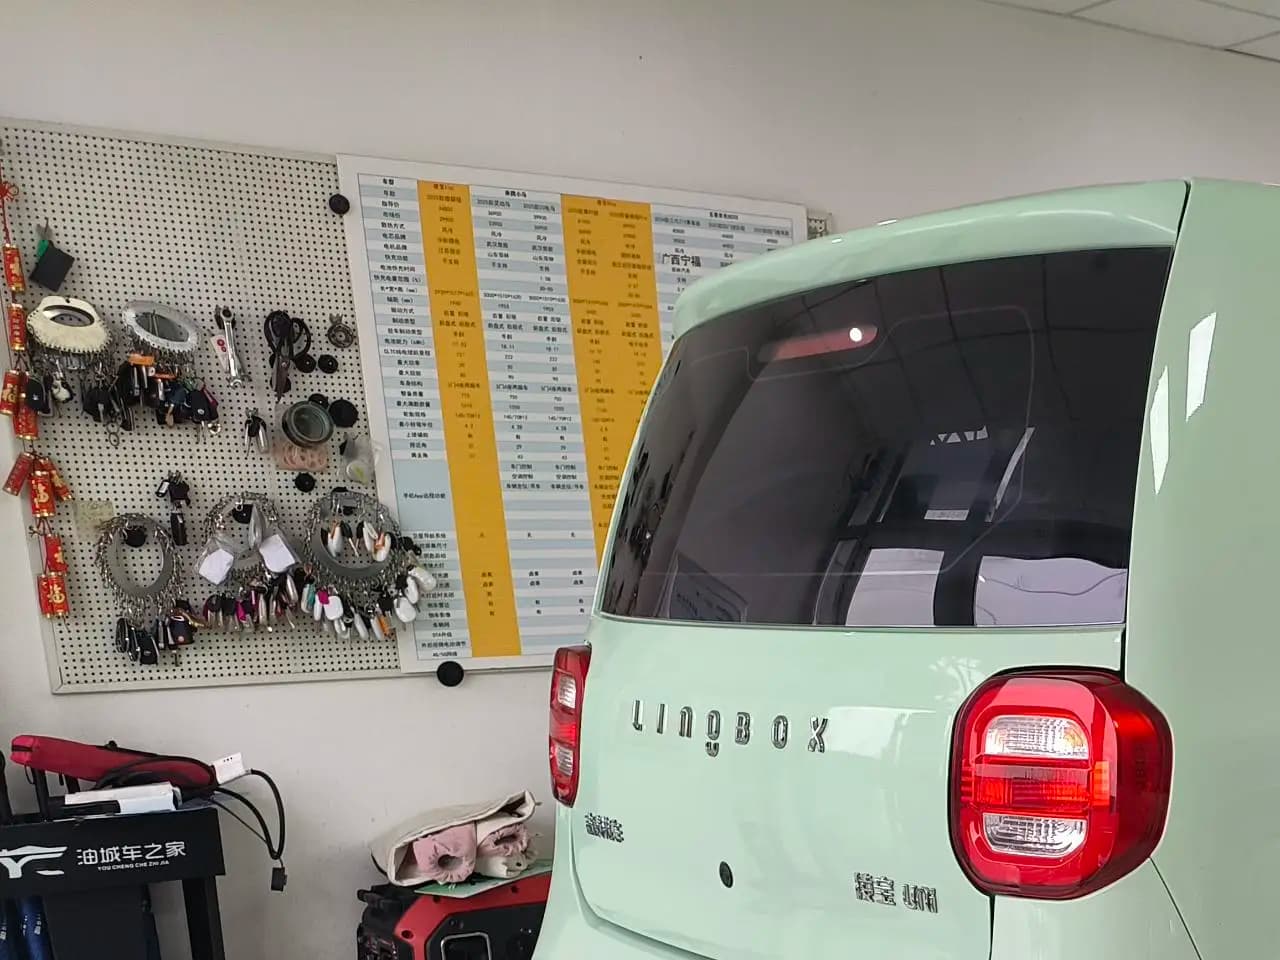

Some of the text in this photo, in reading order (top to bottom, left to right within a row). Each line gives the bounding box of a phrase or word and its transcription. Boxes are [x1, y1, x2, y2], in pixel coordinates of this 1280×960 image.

[662, 253, 702, 268] 广西宁福
[76, 841, 187, 866] 油城车之家
